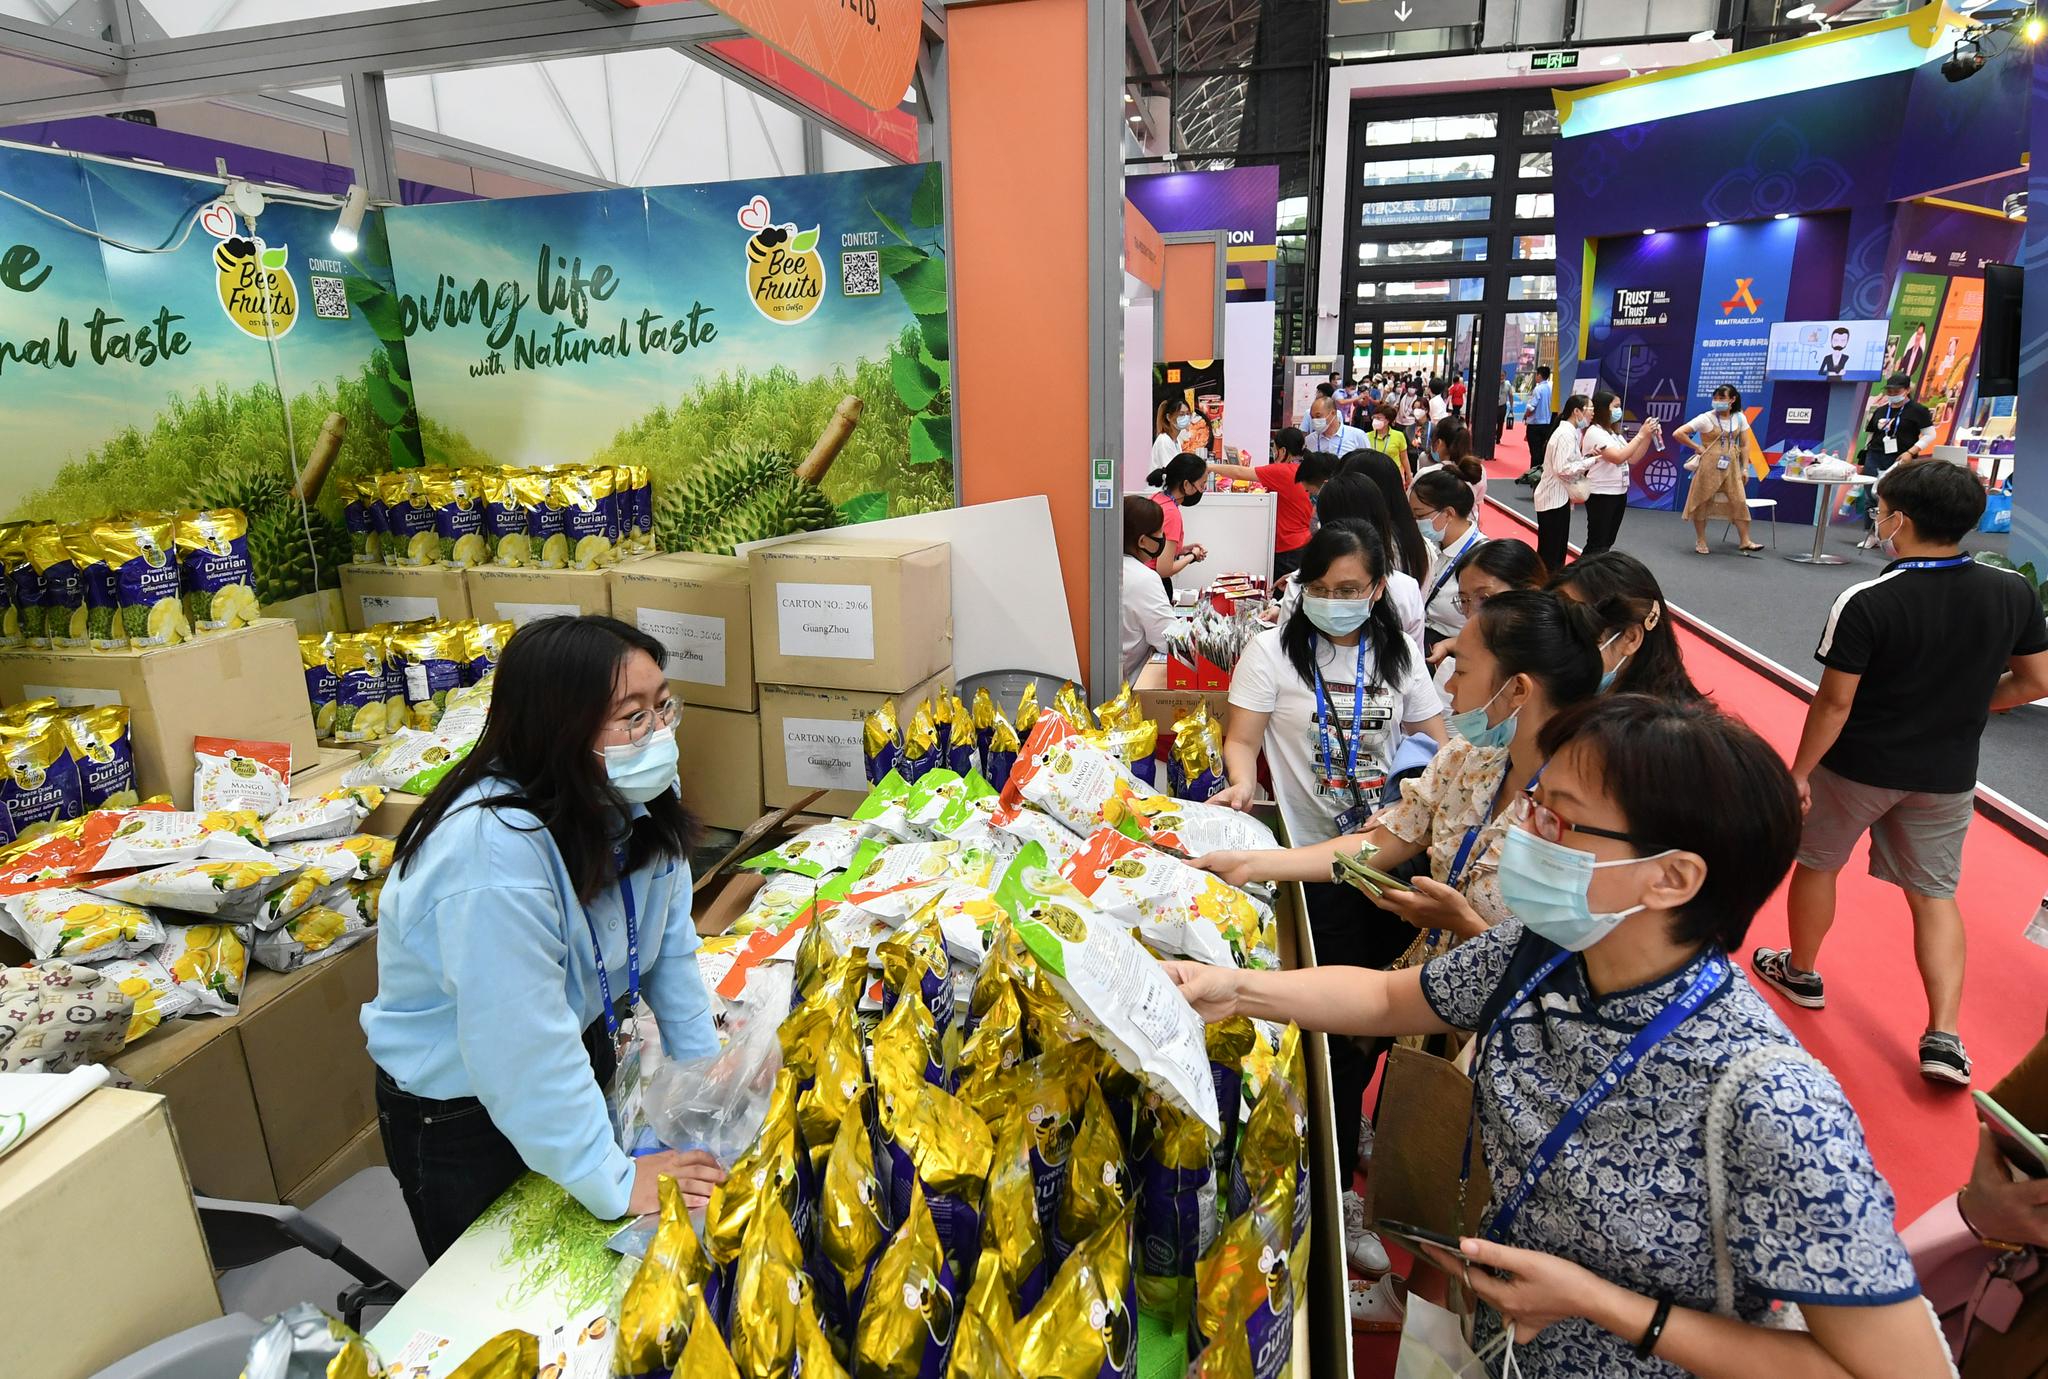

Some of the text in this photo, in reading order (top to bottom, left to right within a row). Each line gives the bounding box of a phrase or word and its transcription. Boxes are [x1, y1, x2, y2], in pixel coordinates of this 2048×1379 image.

[1562, 56, 1576, 64] EXIT
[841, 231, 879, 247] CONTECT
[1227, 230, 1254, 244] ION
[768, 249, 807, 276] Bee
[239, 262, 279, 290] Bee
[755, 274, 820, 300] Fruits
[229, 286, 294, 316] Fruits
[402, 243, 620, 349] oving life
[1617, 289, 1666, 312] TRUST THAI
[1622, 305, 1648, 317] TRUST
[1613, 317, 1657, 326] THAITRADE.COM
[1714, 317, 1764, 325] THAITRADE.COM
[84, 306, 192, 368] taste
[469, 301, 719, 379] with Natural taste
[451, 513, 481, 524] Durian
[573, 514, 607, 525] Durian
[205, 558, 246, 573] Durian
[782, 598, 822, 609] CARTON
[846, 600, 869, 611] 29/66
[802, 623, 850, 635] GuangZhou
[788, 732, 864, 746] CARTON NO.: 63/6
[807, 756, 851, 768] GuangZhou
[89, 761, 130, 784] Durian
[1072, 761, 1090, 790] MANGO
[231, 782, 264, 791] MANGO
[7, 789, 62, 810] Durian
[1336, 815, 1349, 827] 18
[1151, 864, 1167, 887] MANGO
